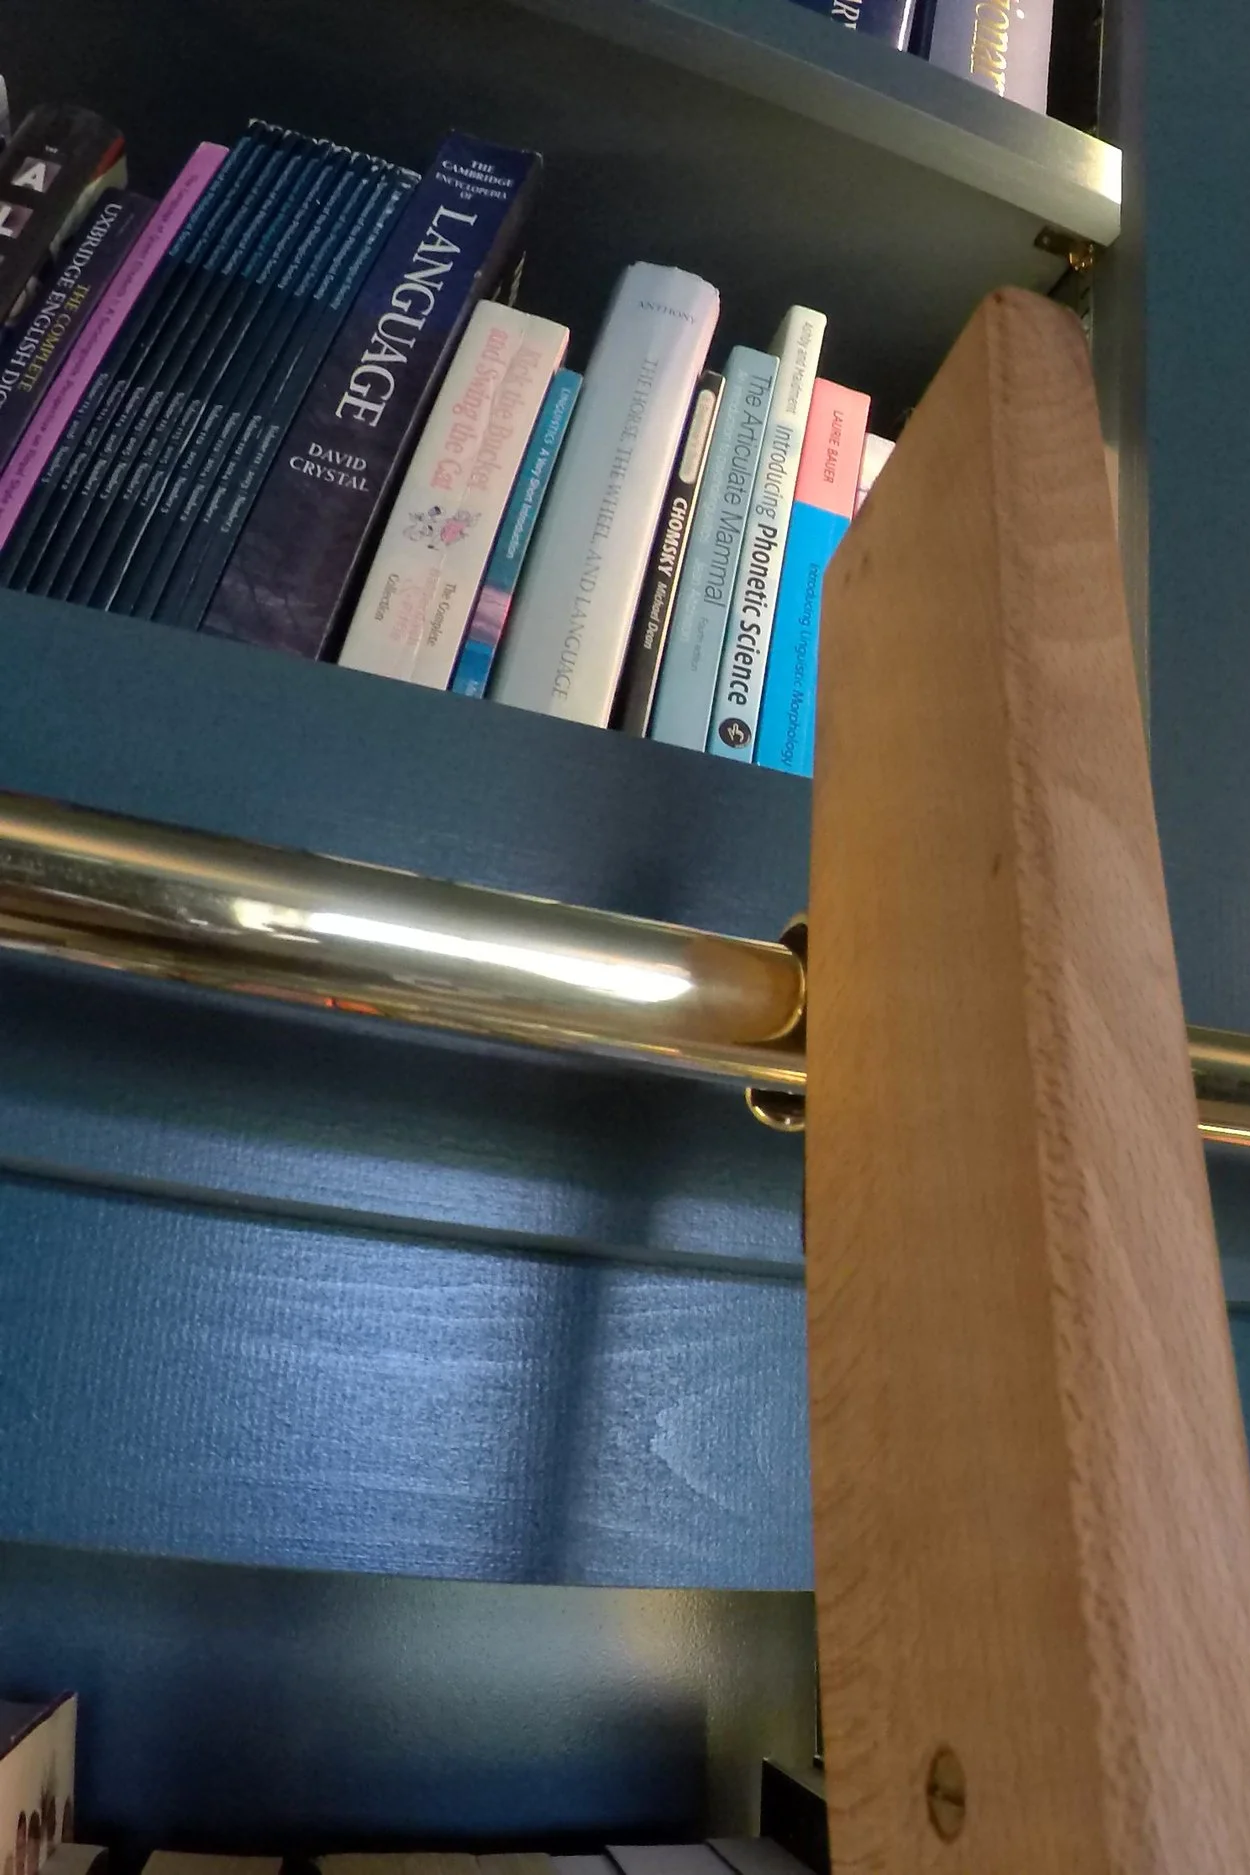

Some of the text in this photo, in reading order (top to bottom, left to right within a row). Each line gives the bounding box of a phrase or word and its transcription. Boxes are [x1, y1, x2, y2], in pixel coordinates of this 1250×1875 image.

[435, 173, 509, 200] ENCYCLOPEDIA
[441, 160, 515, 187] CAMBRIDGE
[471, 160, 496, 172] THE
[56, 197, 123, 293] UXBRIDGE
[9, 287, 66, 369] ENGLISH
[15, 280, 91, 395] THE COMPLETE
[335, 205, 478, 428] LANGUAGE
[638, 300, 694, 325] ANTHONY
[635, 356, 659, 389] THE
[426, 325, 514, 497] and Swing the Cat
[459, 342, 543, 496] Kick the Bucket
[308, 442, 368, 472] DAVID
[529, 455, 547, 476] Very
[607, 444, 633, 483] THE
[821, 410, 845, 483] LAURIE BAUER
[289, 457, 370, 493] CRYSTAL
[523, 476, 540, 502] Short
[700, 371, 772, 607] The Articulate Mammal
[504, 502, 532, 559] Introduction
[576, 547, 606, 594] AND
[643, 496, 689, 650] CHOMSKY Michael Dean
[725, 423, 796, 707] Introducing Phonetic Science
[371, 571, 402, 623] Collection
[440, 581, 458, 602] The
[422, 599, 454, 648] Complete
[546, 594, 595, 700] LANGUAGE
[777, 561, 822, 767] Introducing Linguistic Morphology
